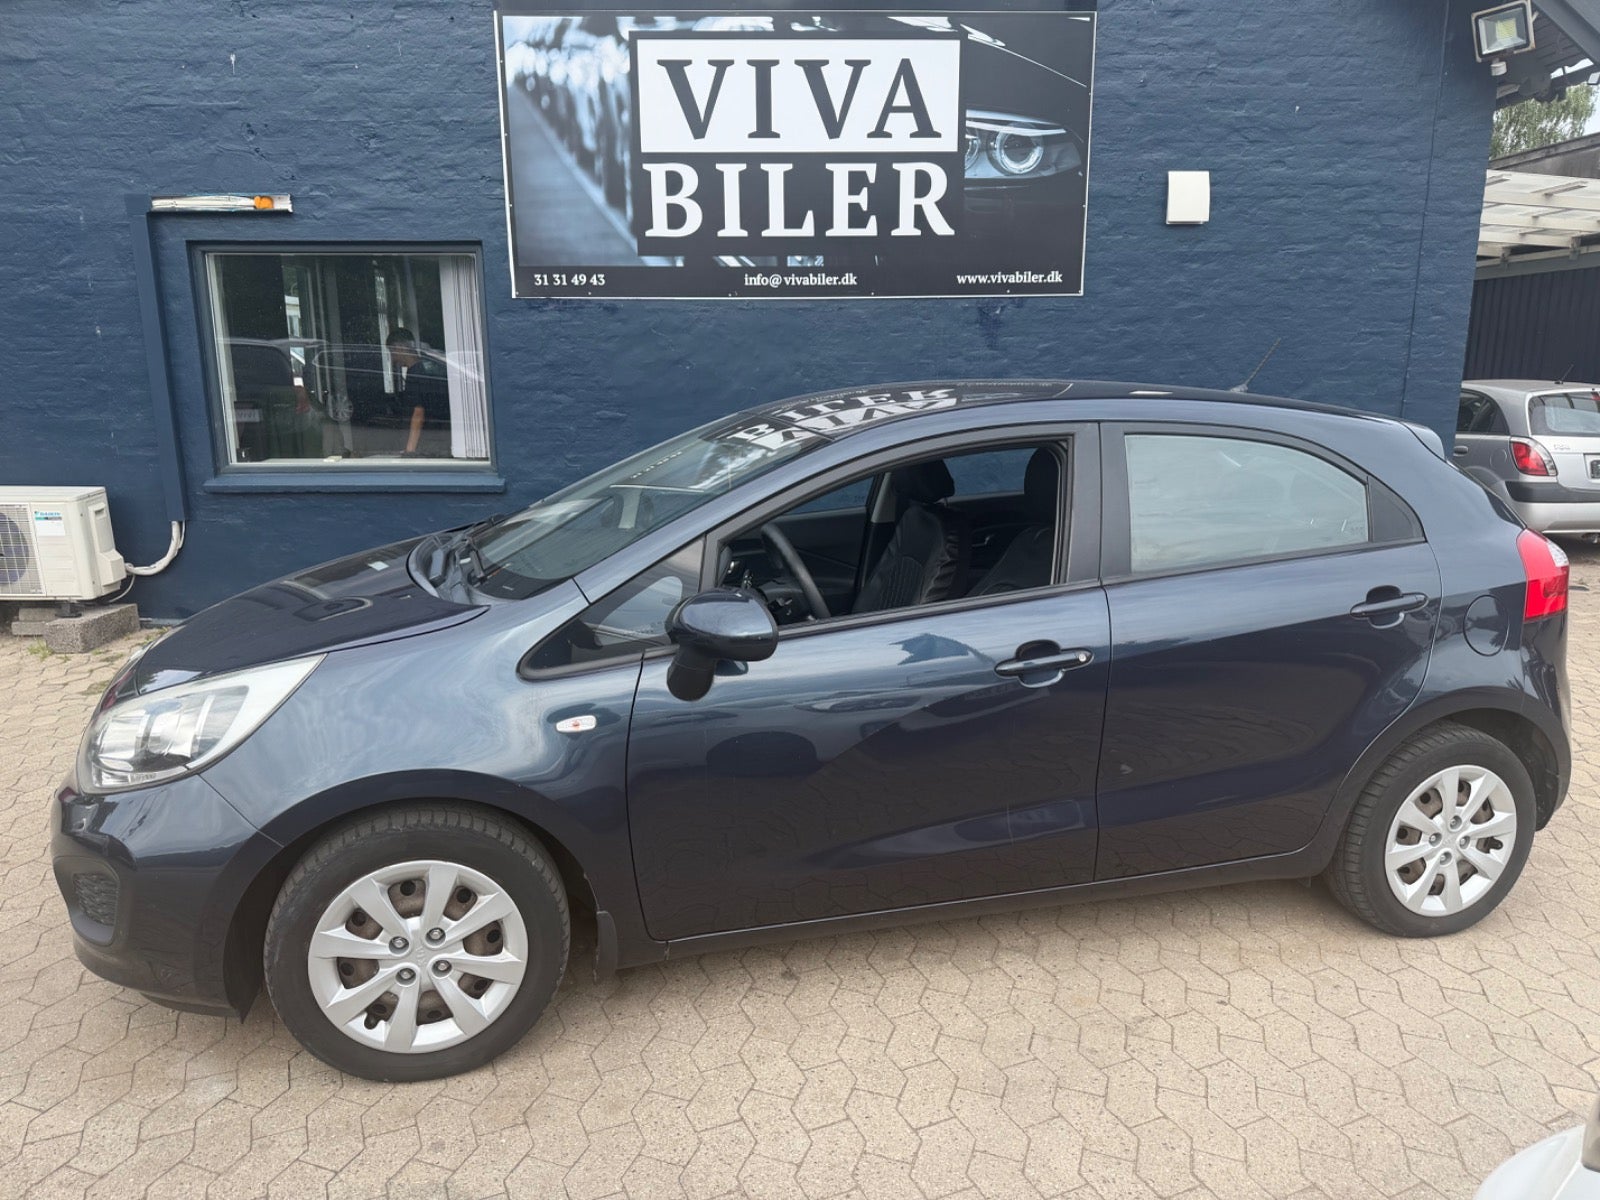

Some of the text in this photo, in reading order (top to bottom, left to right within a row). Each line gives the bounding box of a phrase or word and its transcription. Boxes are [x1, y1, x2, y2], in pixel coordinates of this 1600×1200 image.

[657, 58, 942, 140] VIVA
[642, 162, 955, 237] BILER
[533, 273, 606, 286] 31 31 49 43
[743, 272, 858, 288] info@vivabiler.dk
[956, 270, 1063, 285] www.vivabiler.dk
